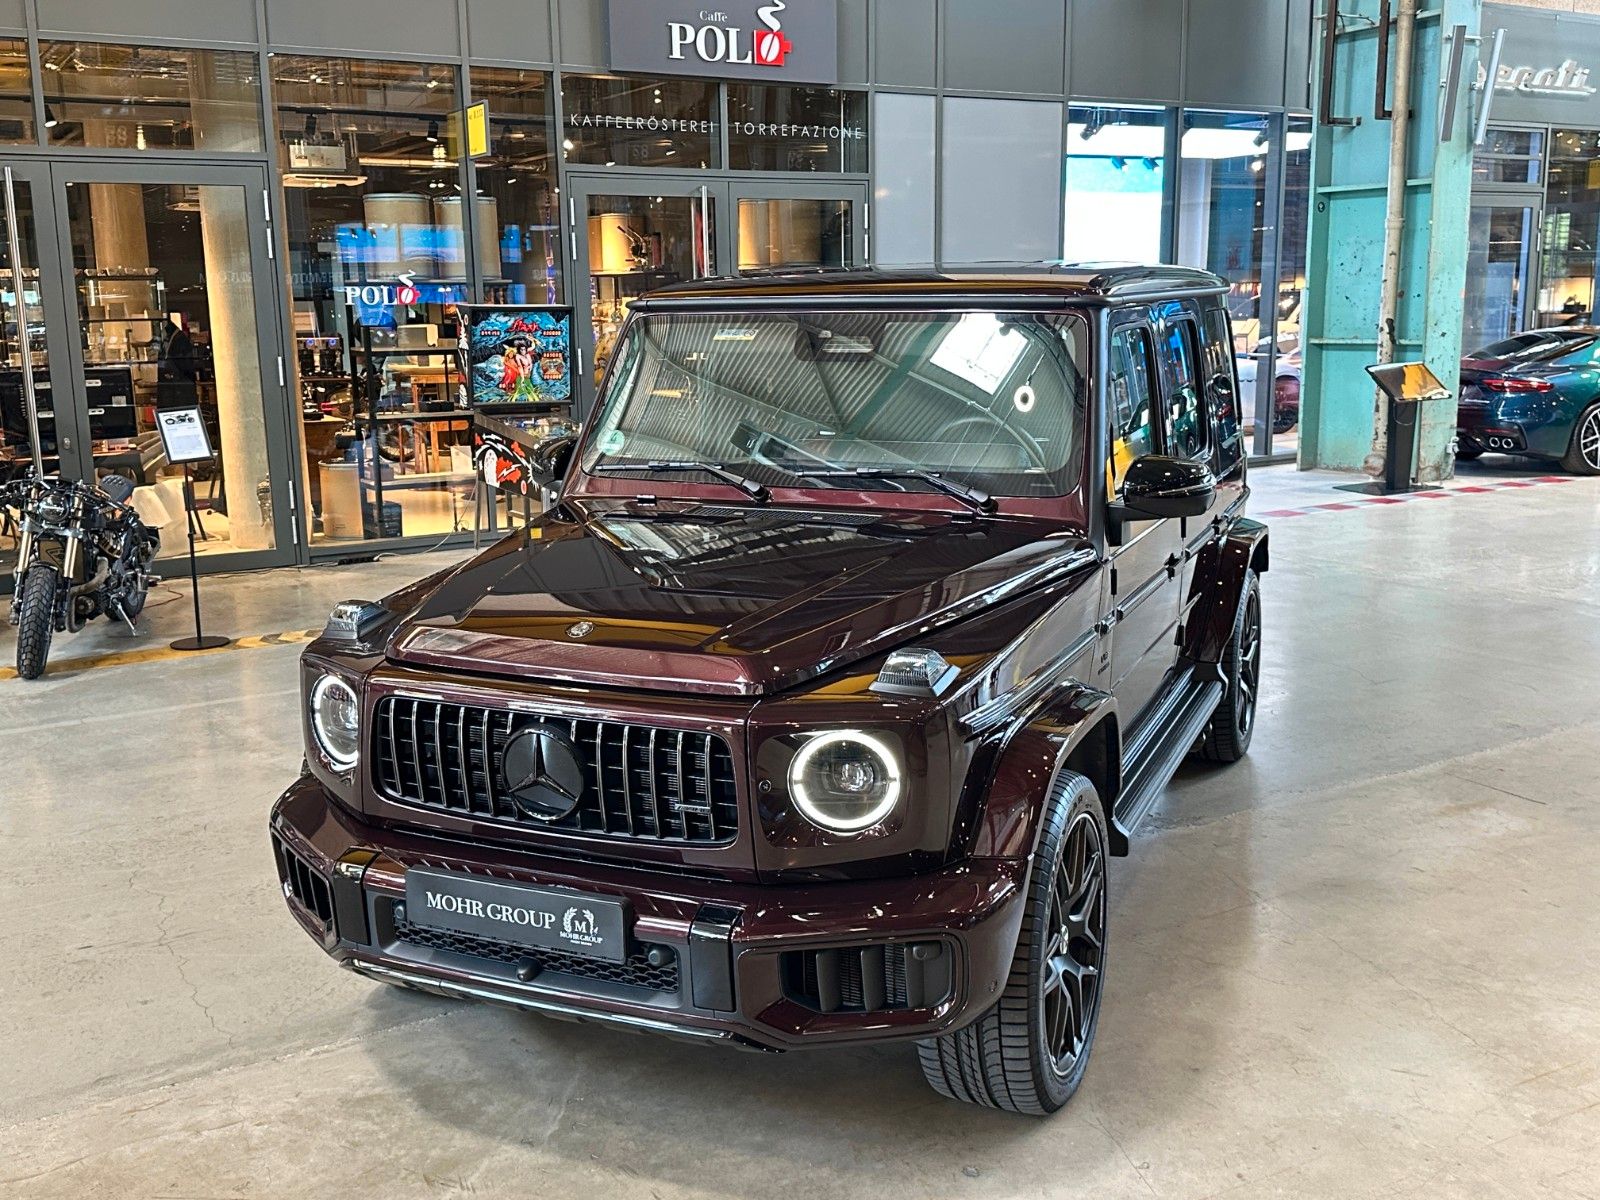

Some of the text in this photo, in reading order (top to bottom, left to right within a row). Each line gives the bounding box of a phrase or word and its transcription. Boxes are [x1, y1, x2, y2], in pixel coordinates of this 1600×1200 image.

[570, 114, 863, 140] KAFFEERÖSTEREI TORREFAZIONE
[425, 891, 556, 930] MOHR GROUP
[573, 920, 587, 933] M
